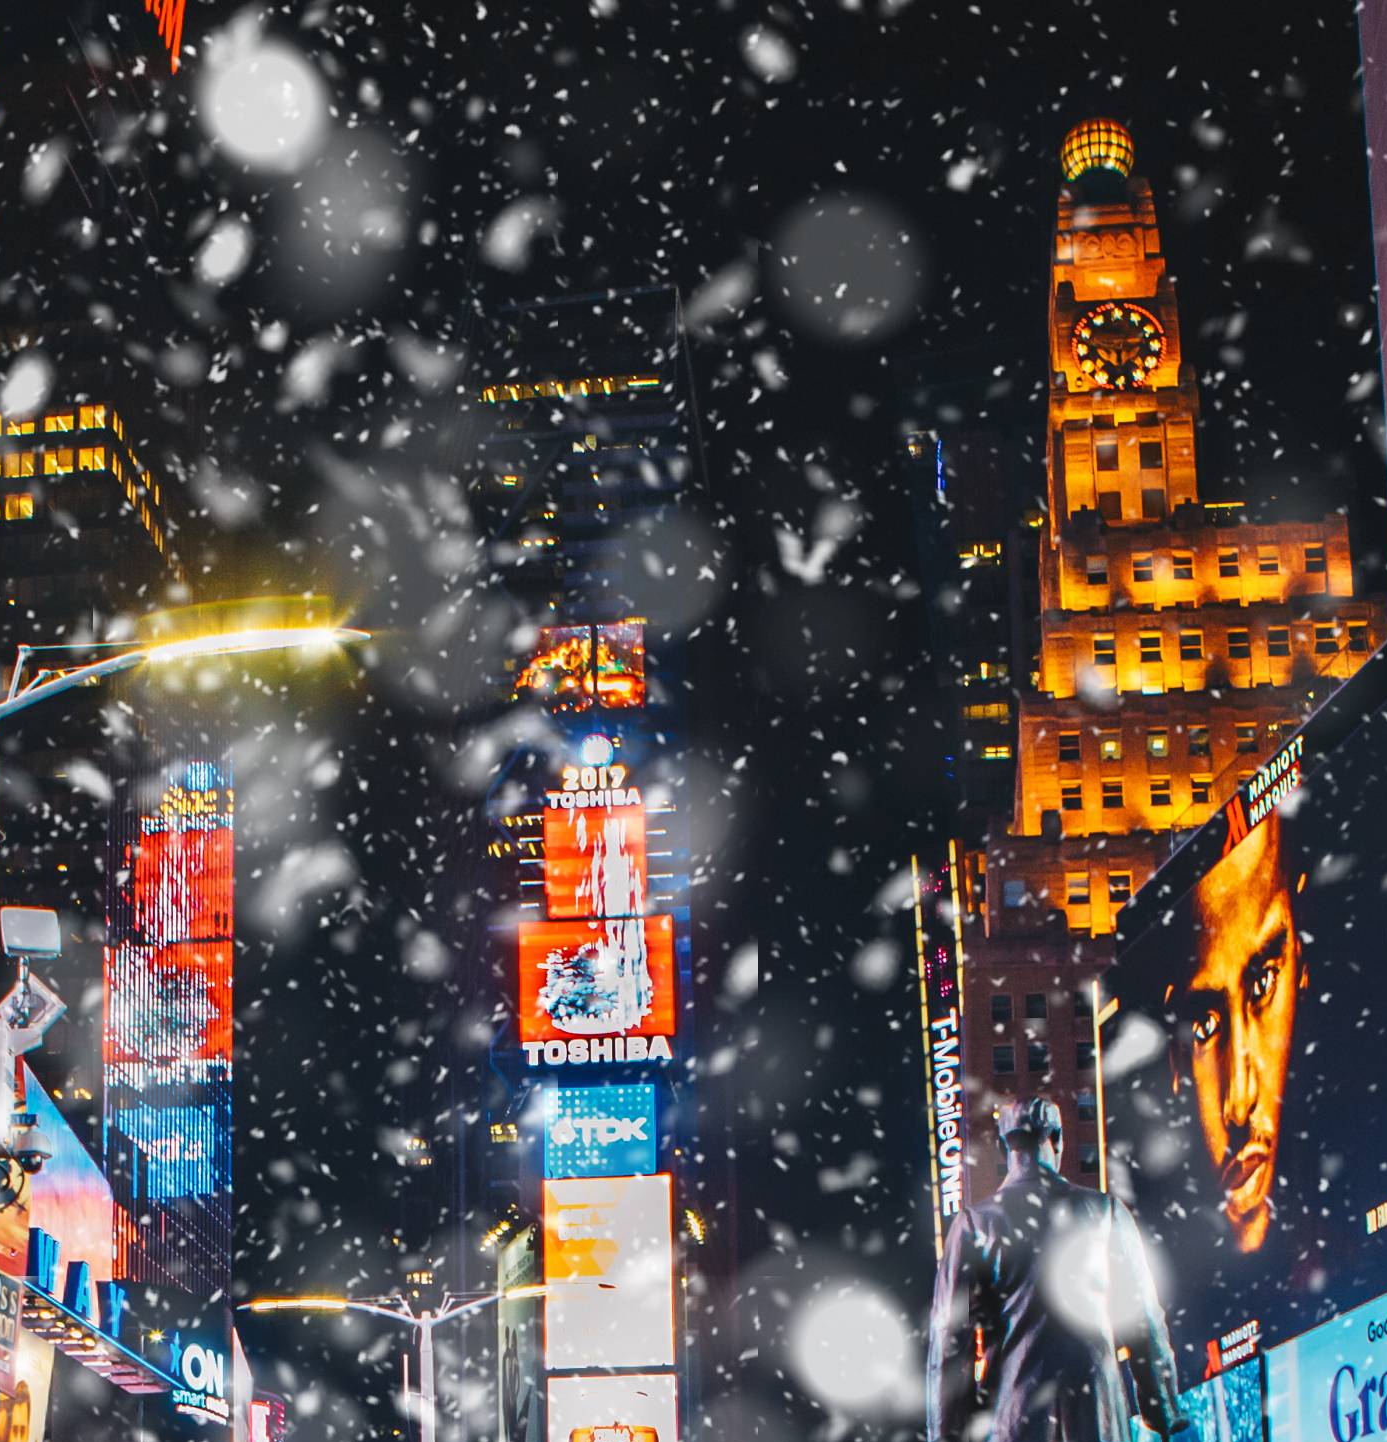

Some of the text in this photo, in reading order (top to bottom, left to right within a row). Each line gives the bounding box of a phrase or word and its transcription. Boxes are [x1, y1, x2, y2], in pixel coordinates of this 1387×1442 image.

[563, 766, 627, 791] 2017
[1248, 734, 1305, 803] MARRIOTT
[546, 788, 641, 809] TOSHIBA
[1249, 767, 1299, 827] MARQUIS
[522, 1036, 673, 1066] TOSHIBA
[574, 1117, 648, 1147] TDK
